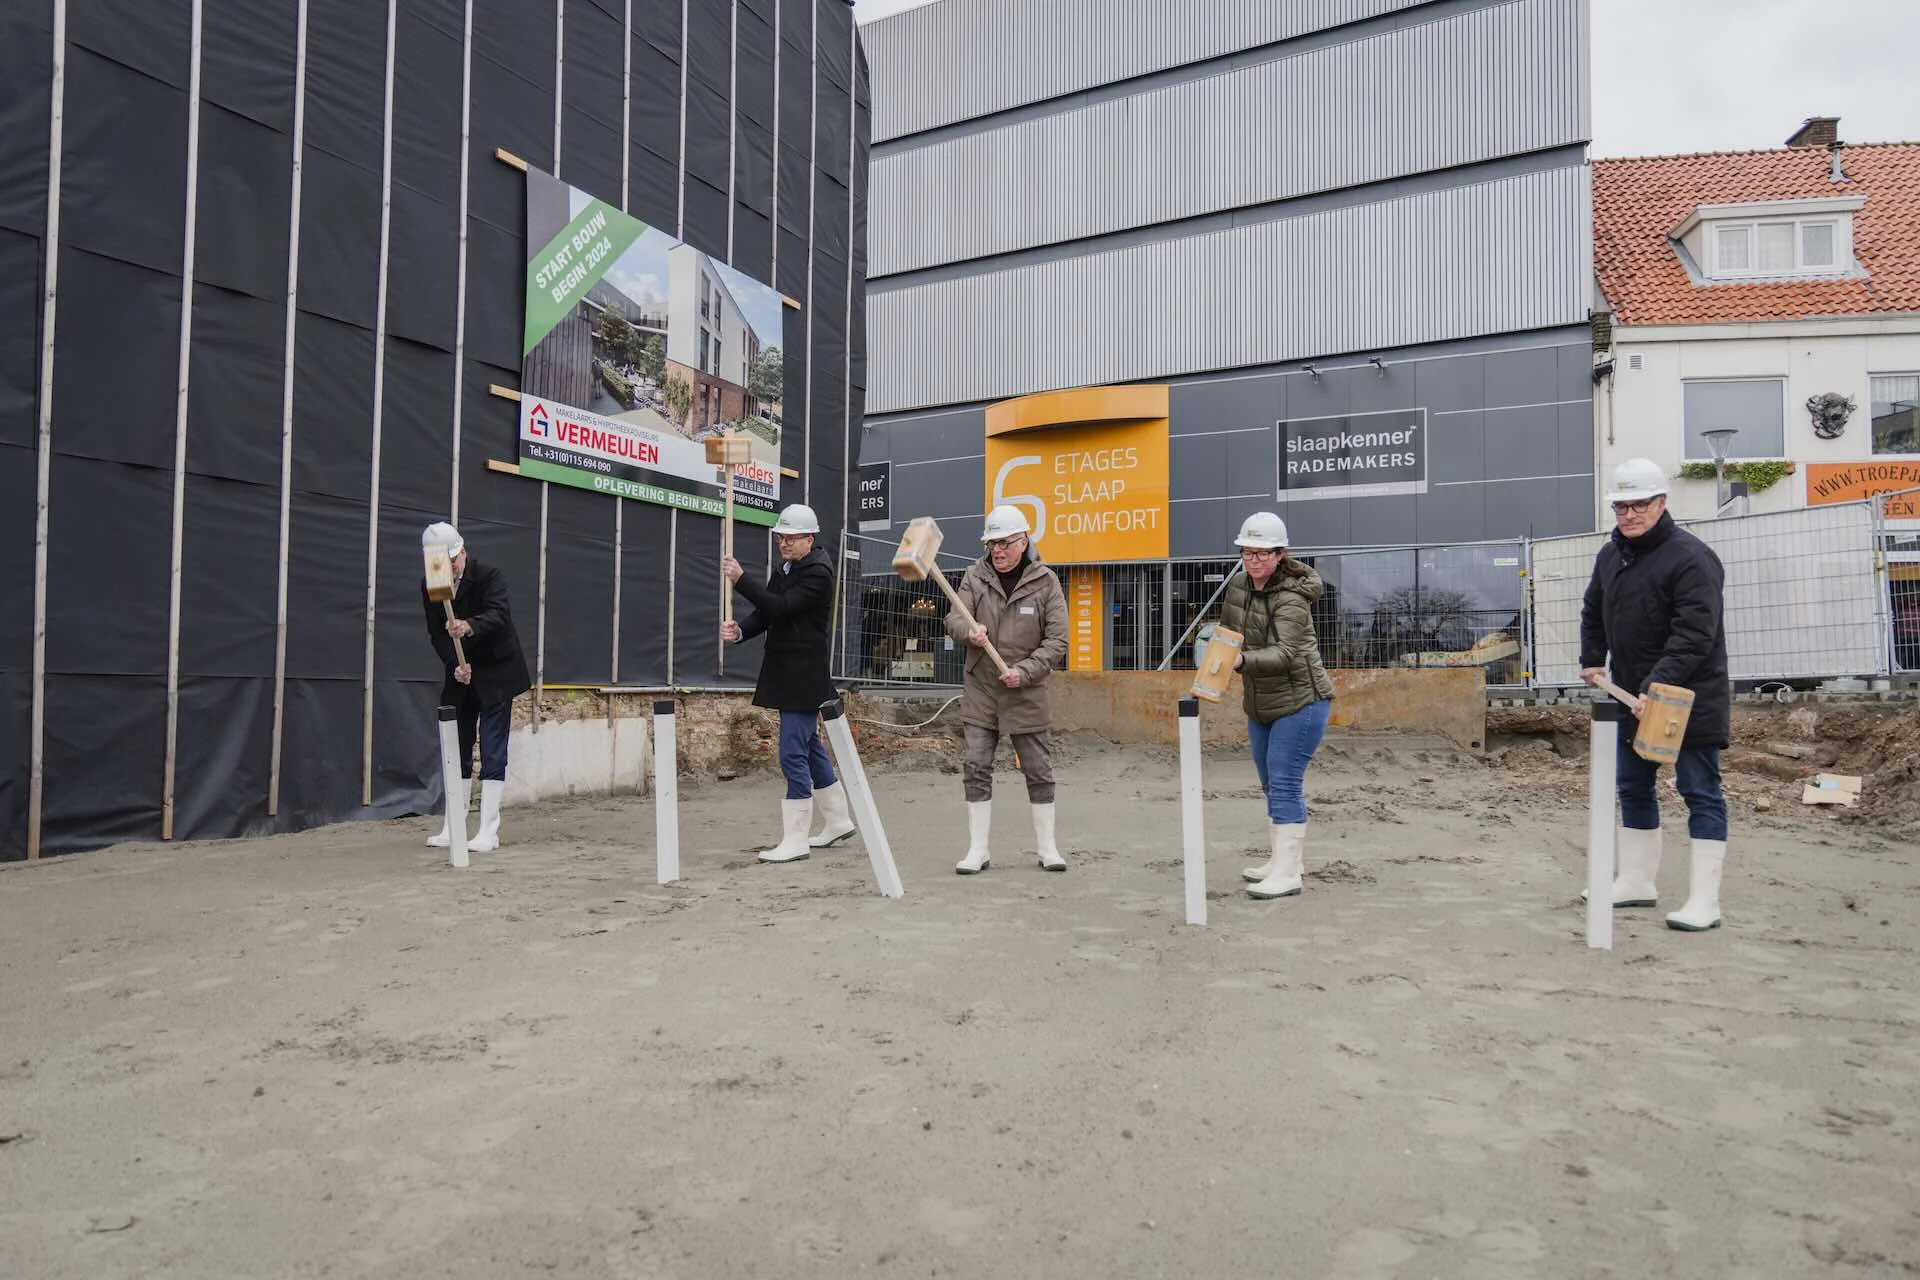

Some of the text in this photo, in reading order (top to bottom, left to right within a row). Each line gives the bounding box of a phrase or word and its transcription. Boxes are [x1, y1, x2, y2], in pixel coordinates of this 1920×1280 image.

[535, 210, 607, 289] START BOUW
[551, 236, 612, 304] BEGIN 2024
[555, 407, 593, 425] MAKELAARS
[555, 419, 659, 465] VERMEULEN
[529, 444, 612, 473] Tel. +31(0)115 694 090
[1054, 447, 1138, 475] ETAGES
[1287, 452, 1416, 474] RADEMAKERS
[594, 476, 725, 515] OPLEVERING BEGIN 2025
[1054, 479, 1127, 505] SLAAP
[1813, 465, 1920, 497] WWW.TROEPJ
[861, 496, 885, 510] ERS
[992, 455, 1046, 543] 6
[1054, 507, 1161, 536] COMFORT
